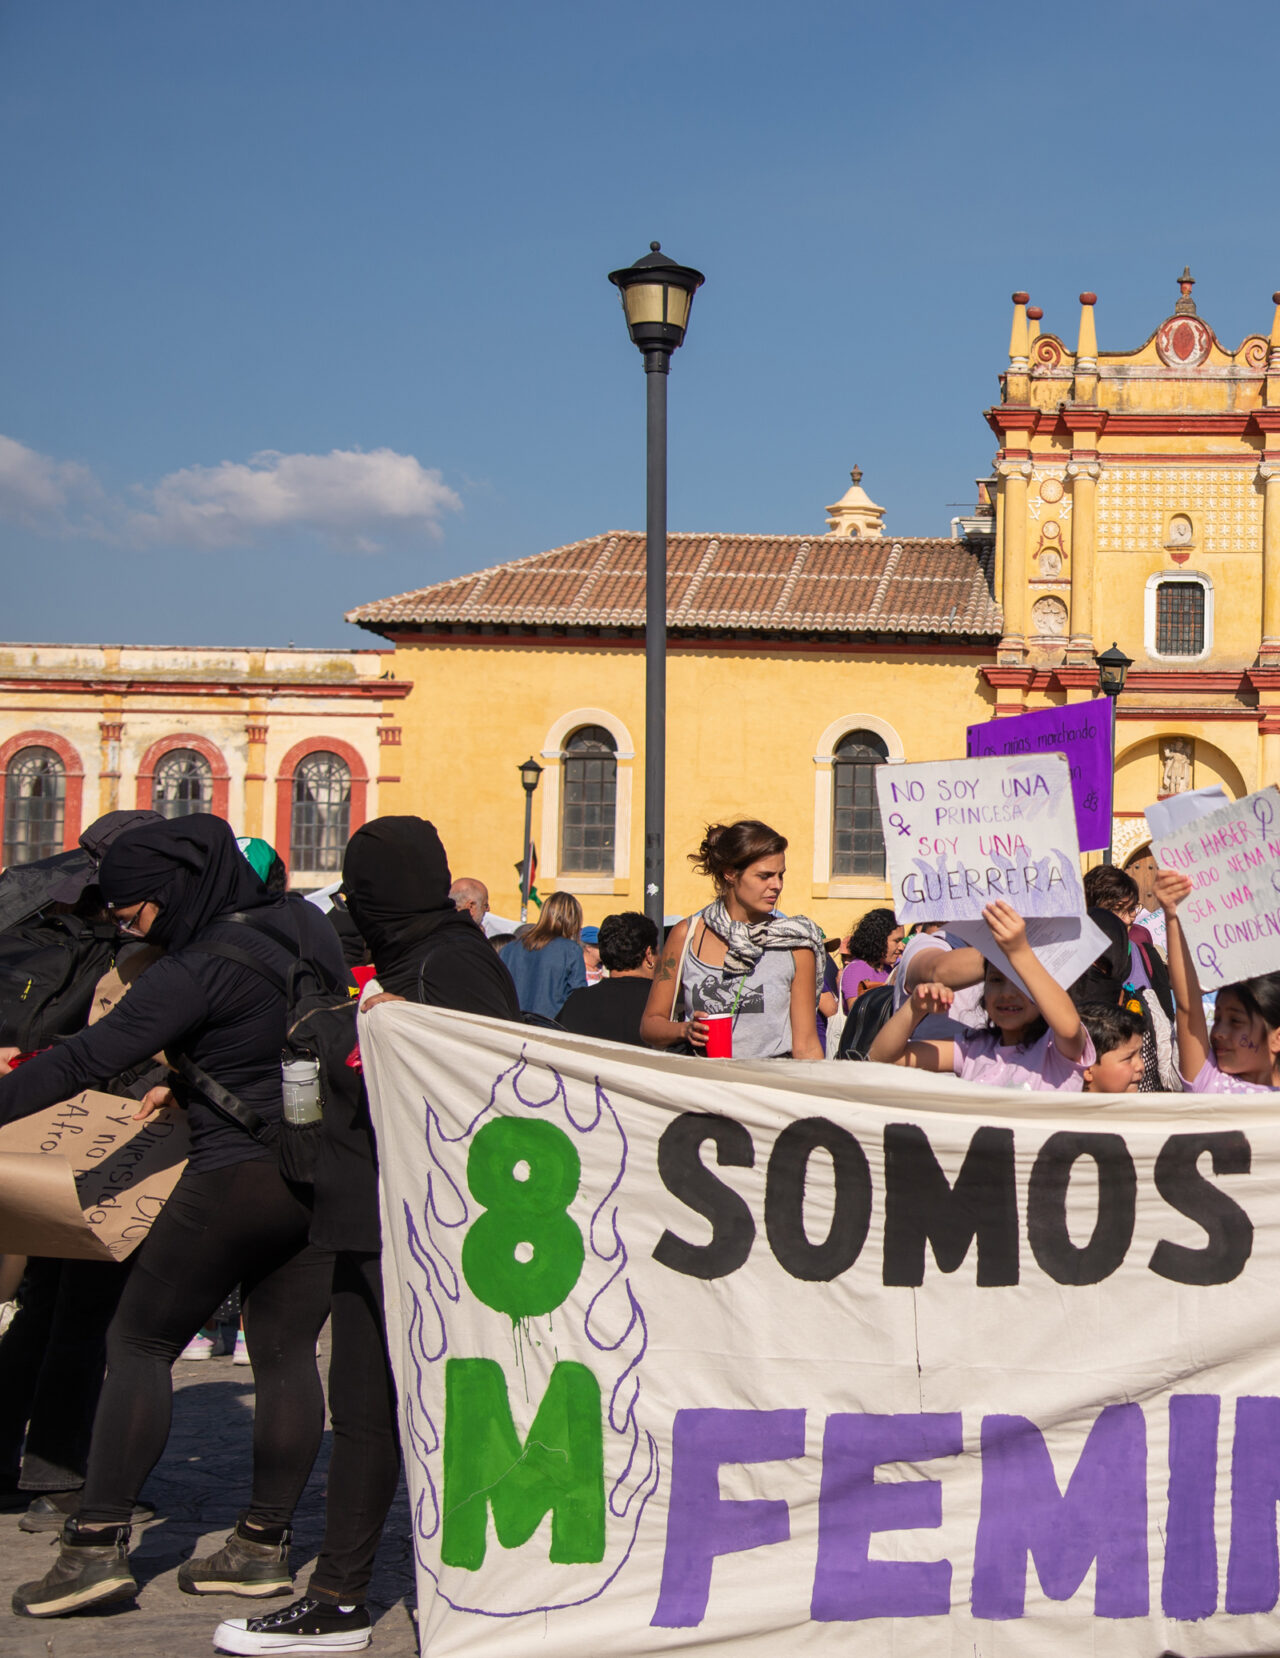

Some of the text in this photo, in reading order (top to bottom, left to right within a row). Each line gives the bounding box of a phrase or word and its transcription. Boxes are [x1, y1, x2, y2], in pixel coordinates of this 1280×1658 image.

[1038, 718, 1097, 748] marchando
[891, 774, 1050, 803] NO SOY UNA
[935, 805, 1023, 826] PRINCESA
[918, 833, 1029, 857] SOY UNA
[1160, 820, 1256, 871] QUE HABER
[901, 866, 1067, 904] GUERRERA
[1190, 866, 1220, 890] CIDO
[1227, 847, 1266, 873] NENA
[1187, 898, 1217, 924] SEA
[1220, 884, 1255, 910] UNA
[462, 1116, 586, 1319] 8
[651, 1111, 1255, 1288] SOMOS
[441, 1358, 606, 1572] M
